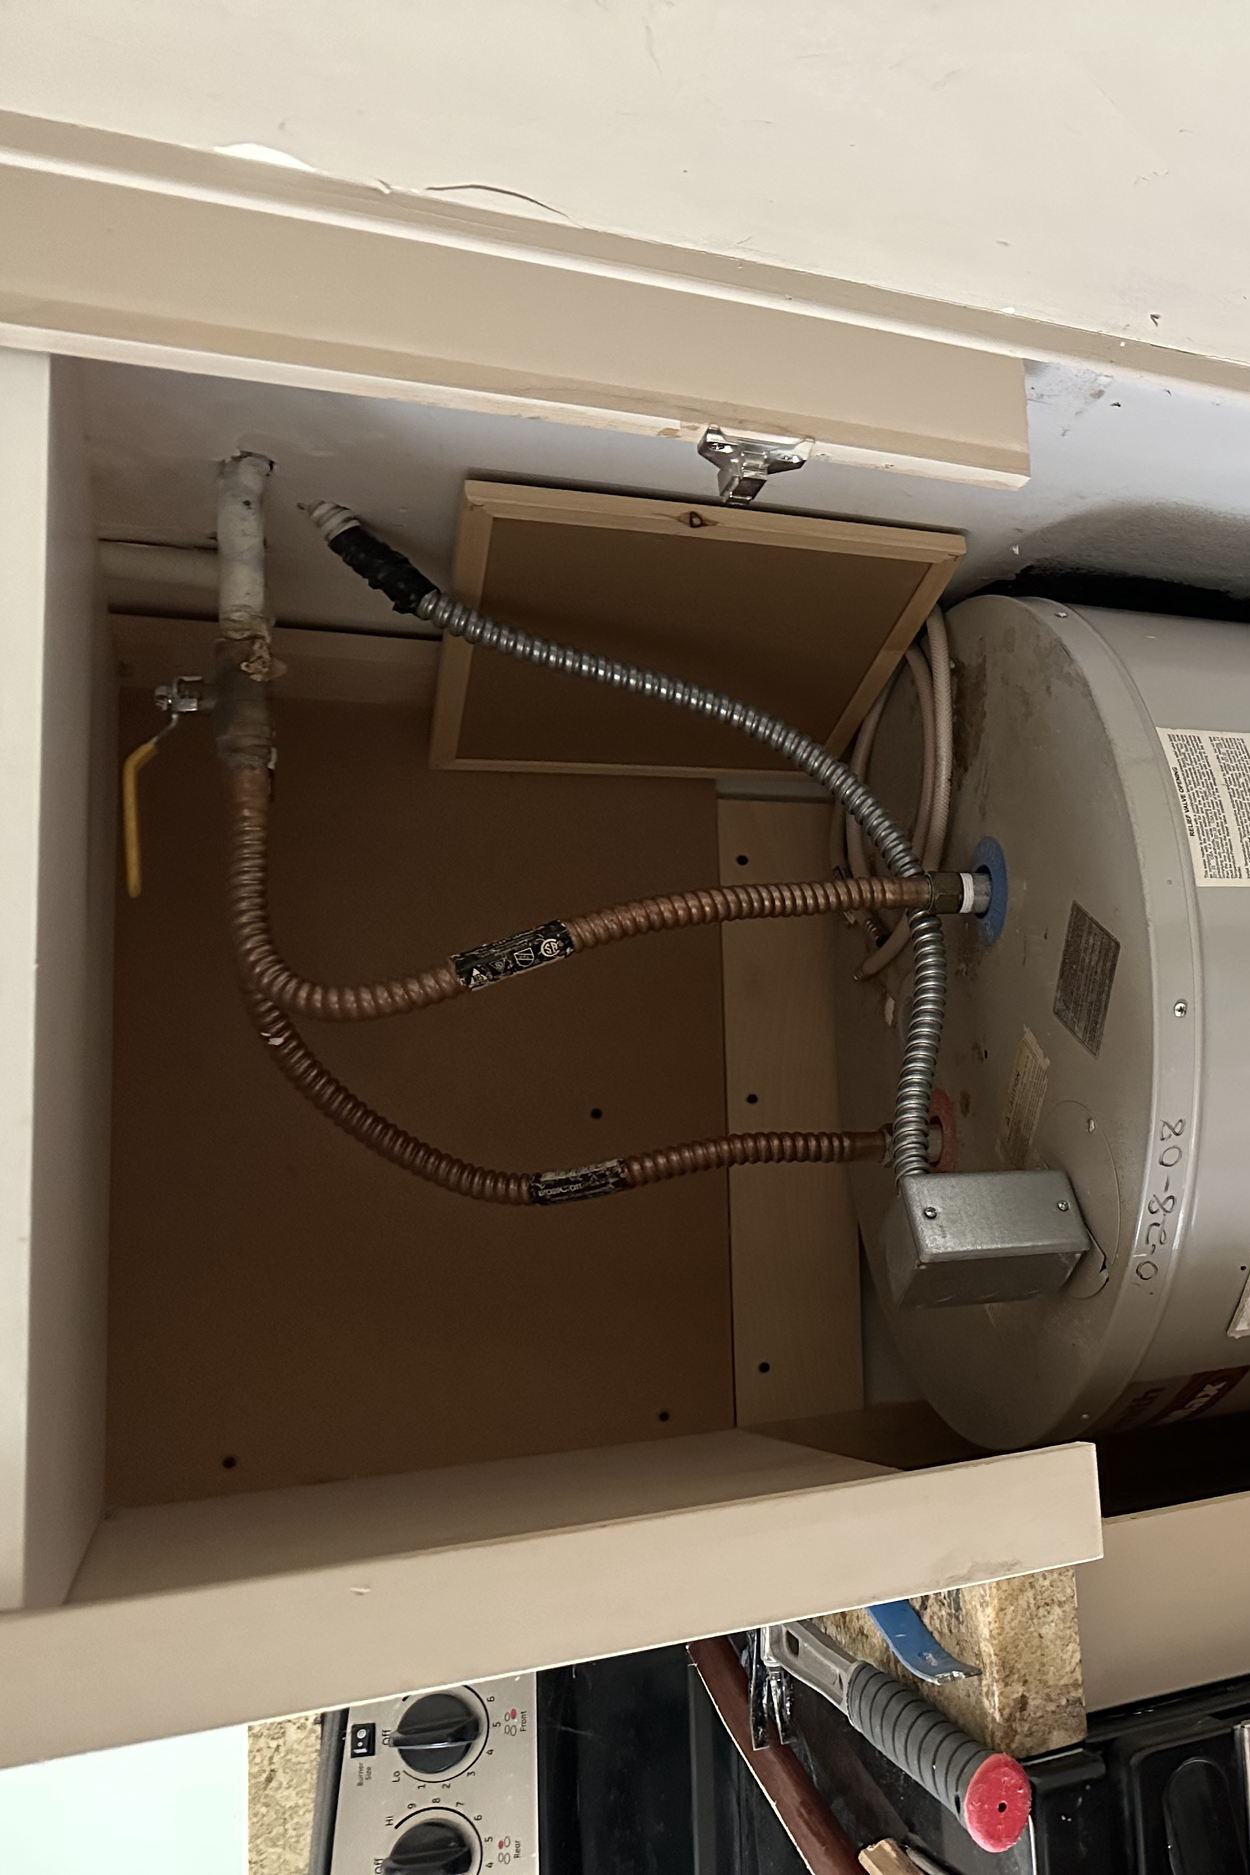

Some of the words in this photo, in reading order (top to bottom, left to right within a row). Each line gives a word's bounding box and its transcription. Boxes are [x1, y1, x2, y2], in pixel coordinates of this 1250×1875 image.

[1171, 766, 1185, 794] OPENING
[1178, 793, 1191, 815] VALVE
[1183, 813, 1196, 838] RELIEF
[486, 1695, 496, 1703] 6
[519, 1710, 528, 1732] Front
[485, 1748, 495, 1756] 4
[357, 1762, 365, 1787] Burner
[365, 1765, 373, 1781] Size
[392, 1770, 401, 1783] Lo
[466, 1770, 476, 1778] 3
[441, 1782, 451, 1790] 2
[431, 1796, 441, 1804] 8
[455, 1800, 465, 1808] 7
[407, 1802, 417, 1810] 9
[385, 1814, 394, 1827] Hi
[473, 1813, 482, 1821] 6
[513, 1840, 521, 1860] Rear
[485, 1861, 494, 1869] 4
